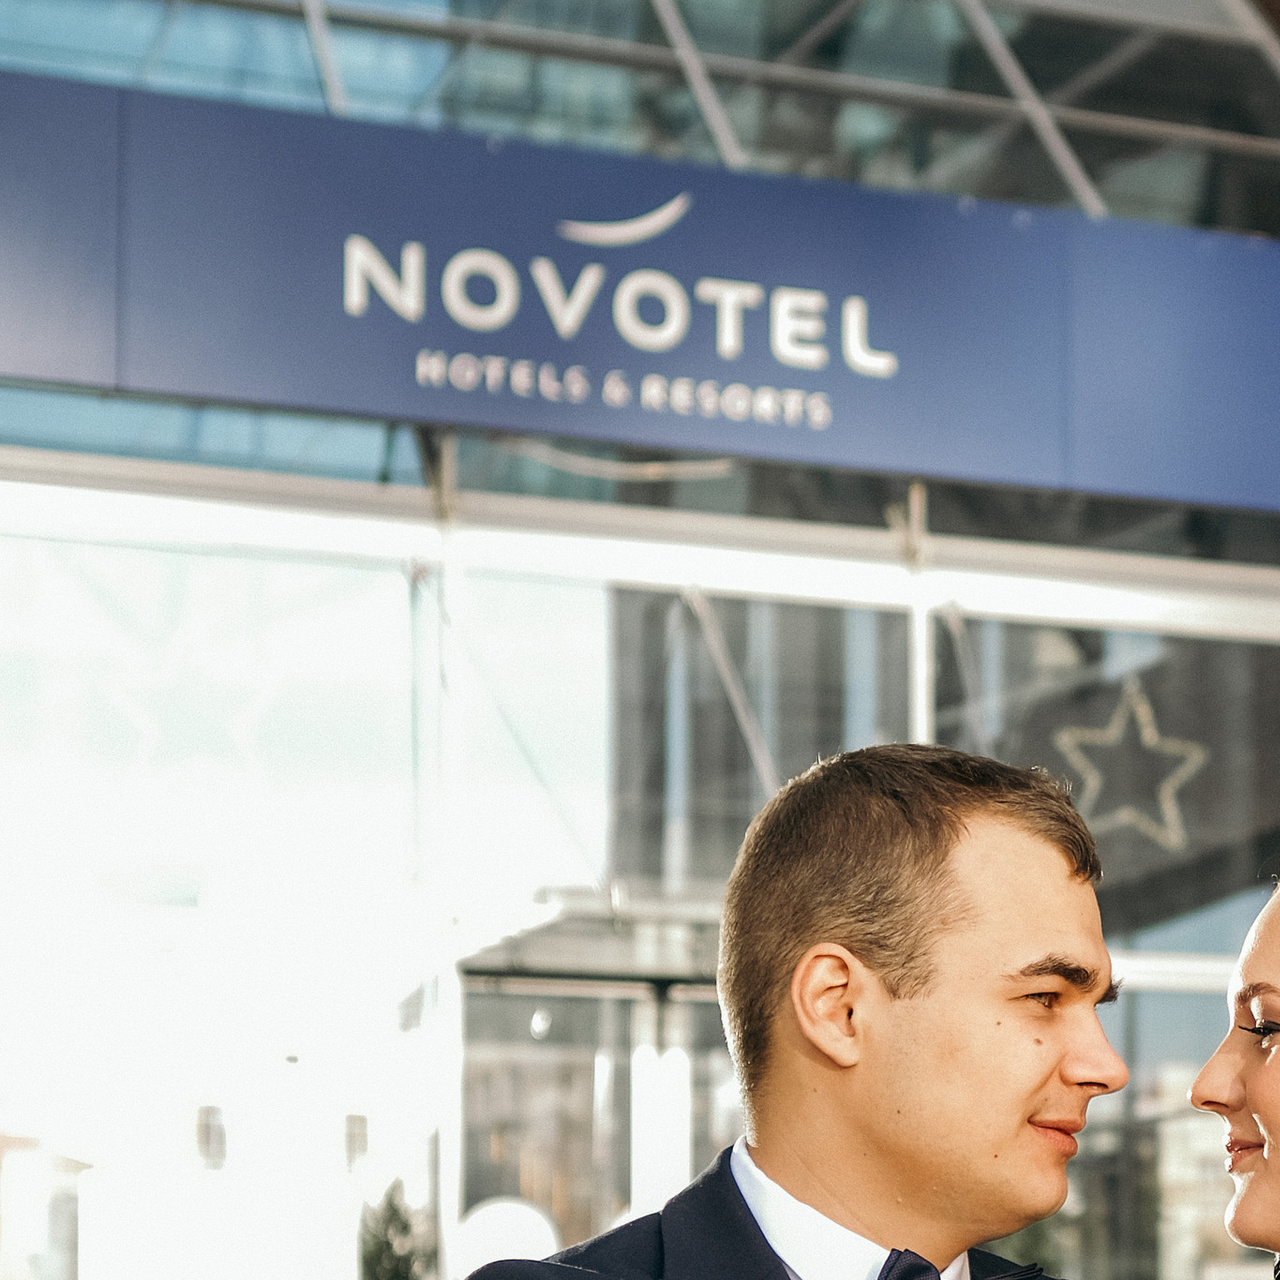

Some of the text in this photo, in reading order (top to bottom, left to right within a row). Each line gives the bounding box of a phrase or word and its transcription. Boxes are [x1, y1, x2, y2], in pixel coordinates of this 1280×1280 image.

[343, 233, 899, 378] NOVOTEL
[415, 348, 833, 431] HOTELS & RESORTS
